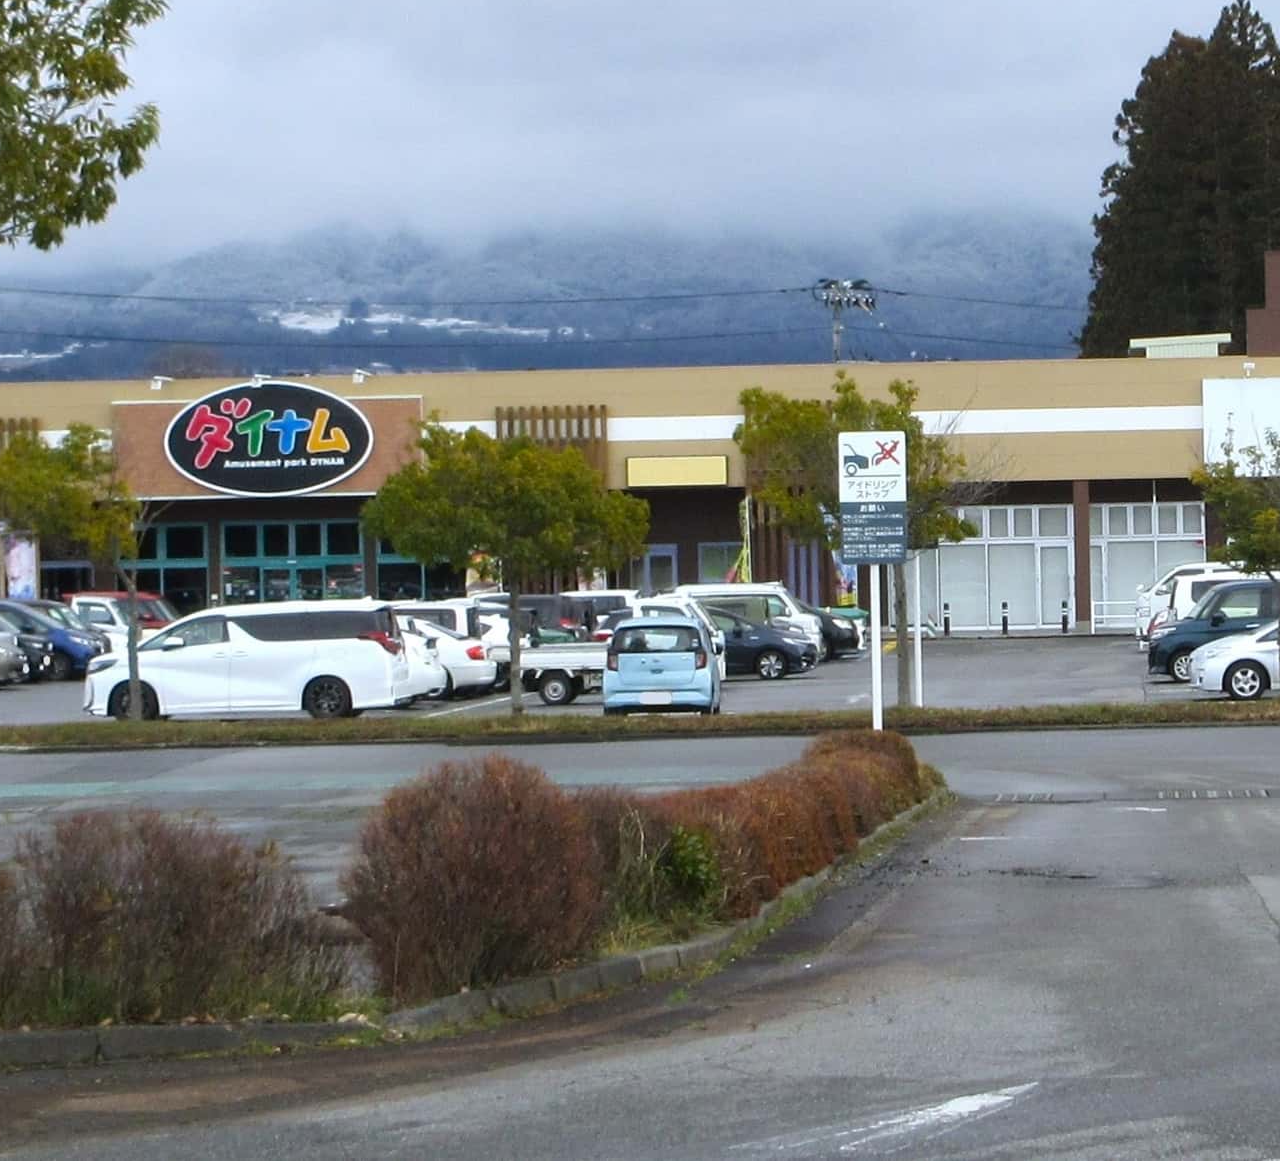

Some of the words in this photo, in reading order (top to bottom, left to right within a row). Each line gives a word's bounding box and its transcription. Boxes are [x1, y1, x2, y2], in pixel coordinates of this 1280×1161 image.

[186, 398, 351, 469] ダイナム
[224, 458, 281, 469] Amusement
[283, 458, 307, 469] park
[310, 457, 345, 467] DYNAM
[847, 480, 898, 490] アイドリング
[856, 489, 889, 499] ストップ
